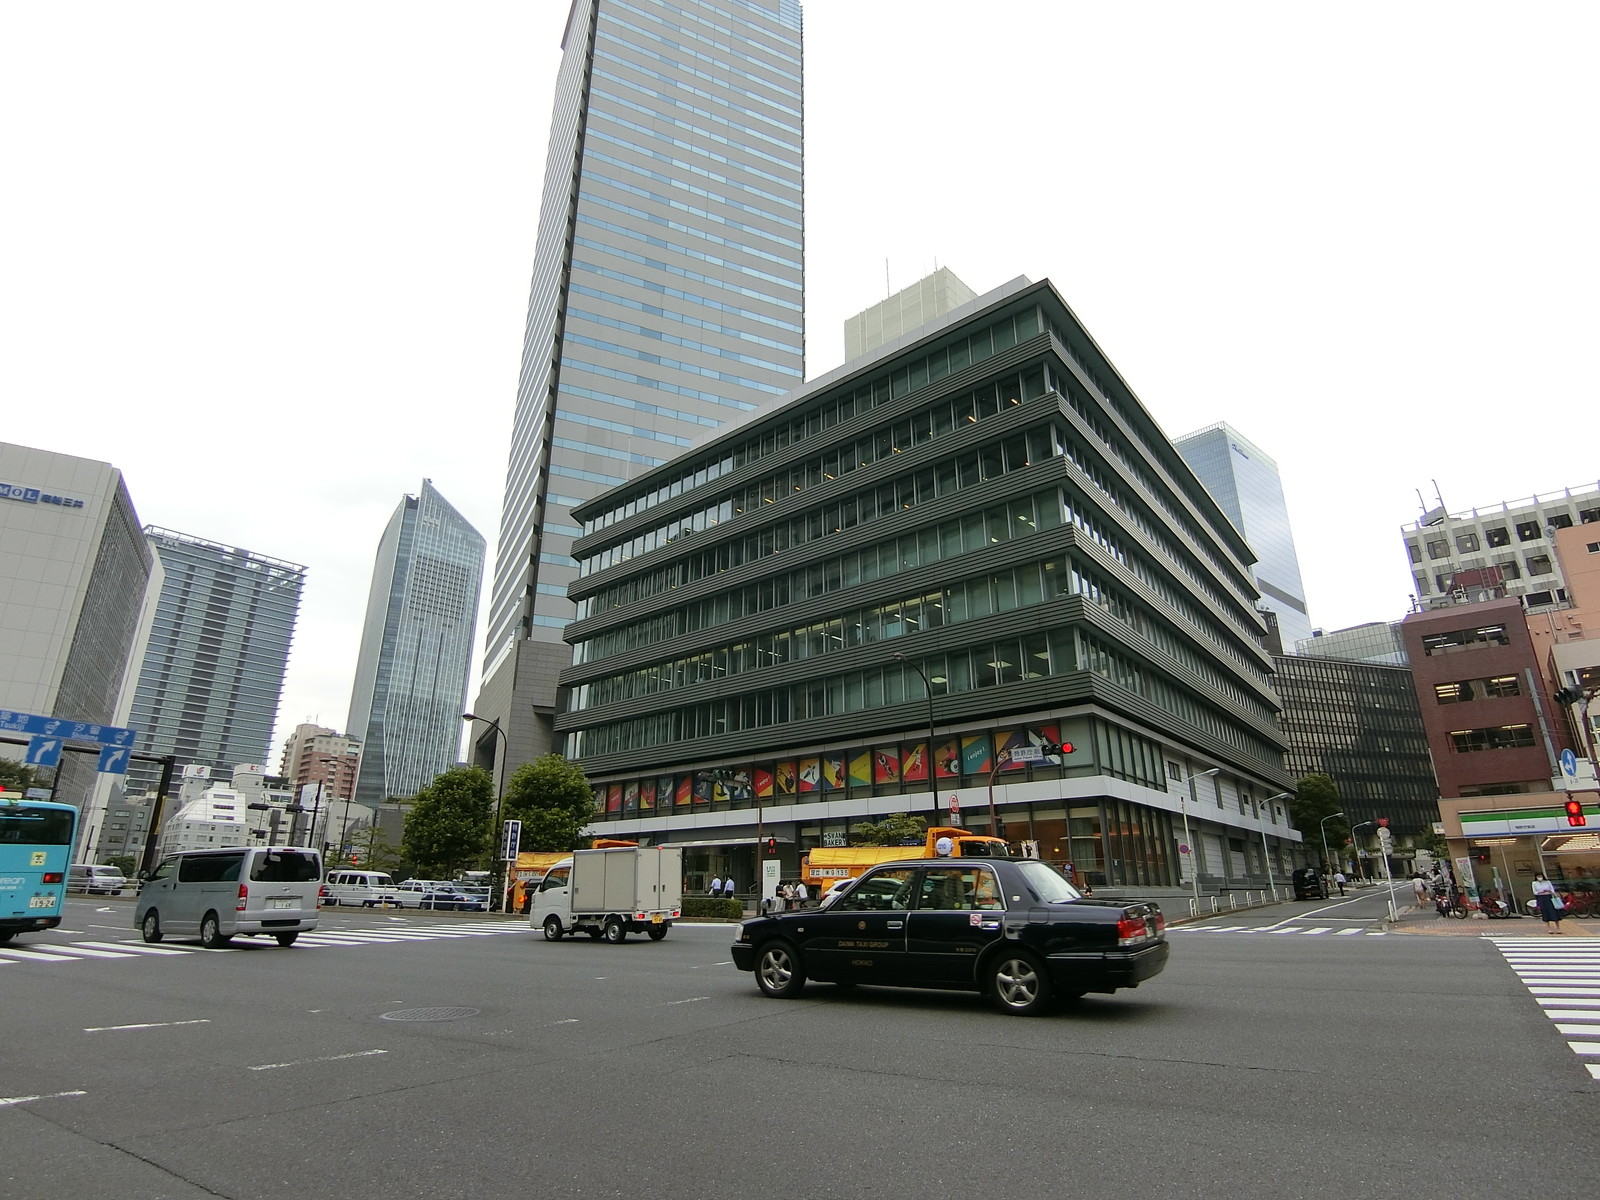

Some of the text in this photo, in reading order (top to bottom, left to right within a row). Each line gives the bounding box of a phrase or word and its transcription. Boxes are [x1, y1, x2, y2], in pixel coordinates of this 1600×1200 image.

[0, 484, 37, 500] MOL
[0, 721, 25, 731] Tsukiji
[74, 723, 101, 735] 汐留
